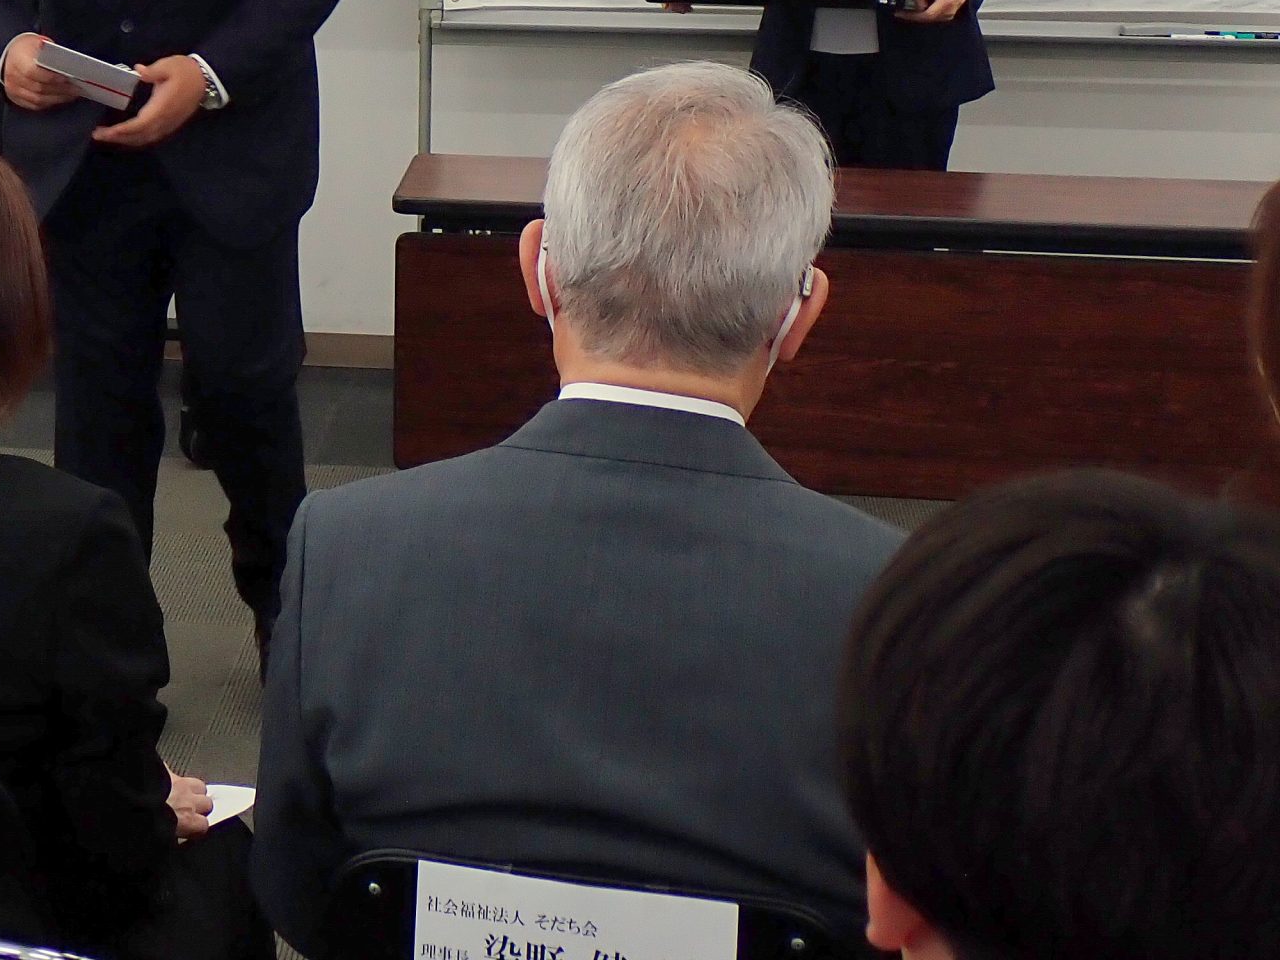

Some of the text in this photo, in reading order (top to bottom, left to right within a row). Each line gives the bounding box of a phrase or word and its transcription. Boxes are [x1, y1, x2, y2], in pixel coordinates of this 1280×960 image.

[427, 895, 598, 939] 社会福祉法人 そだち会
